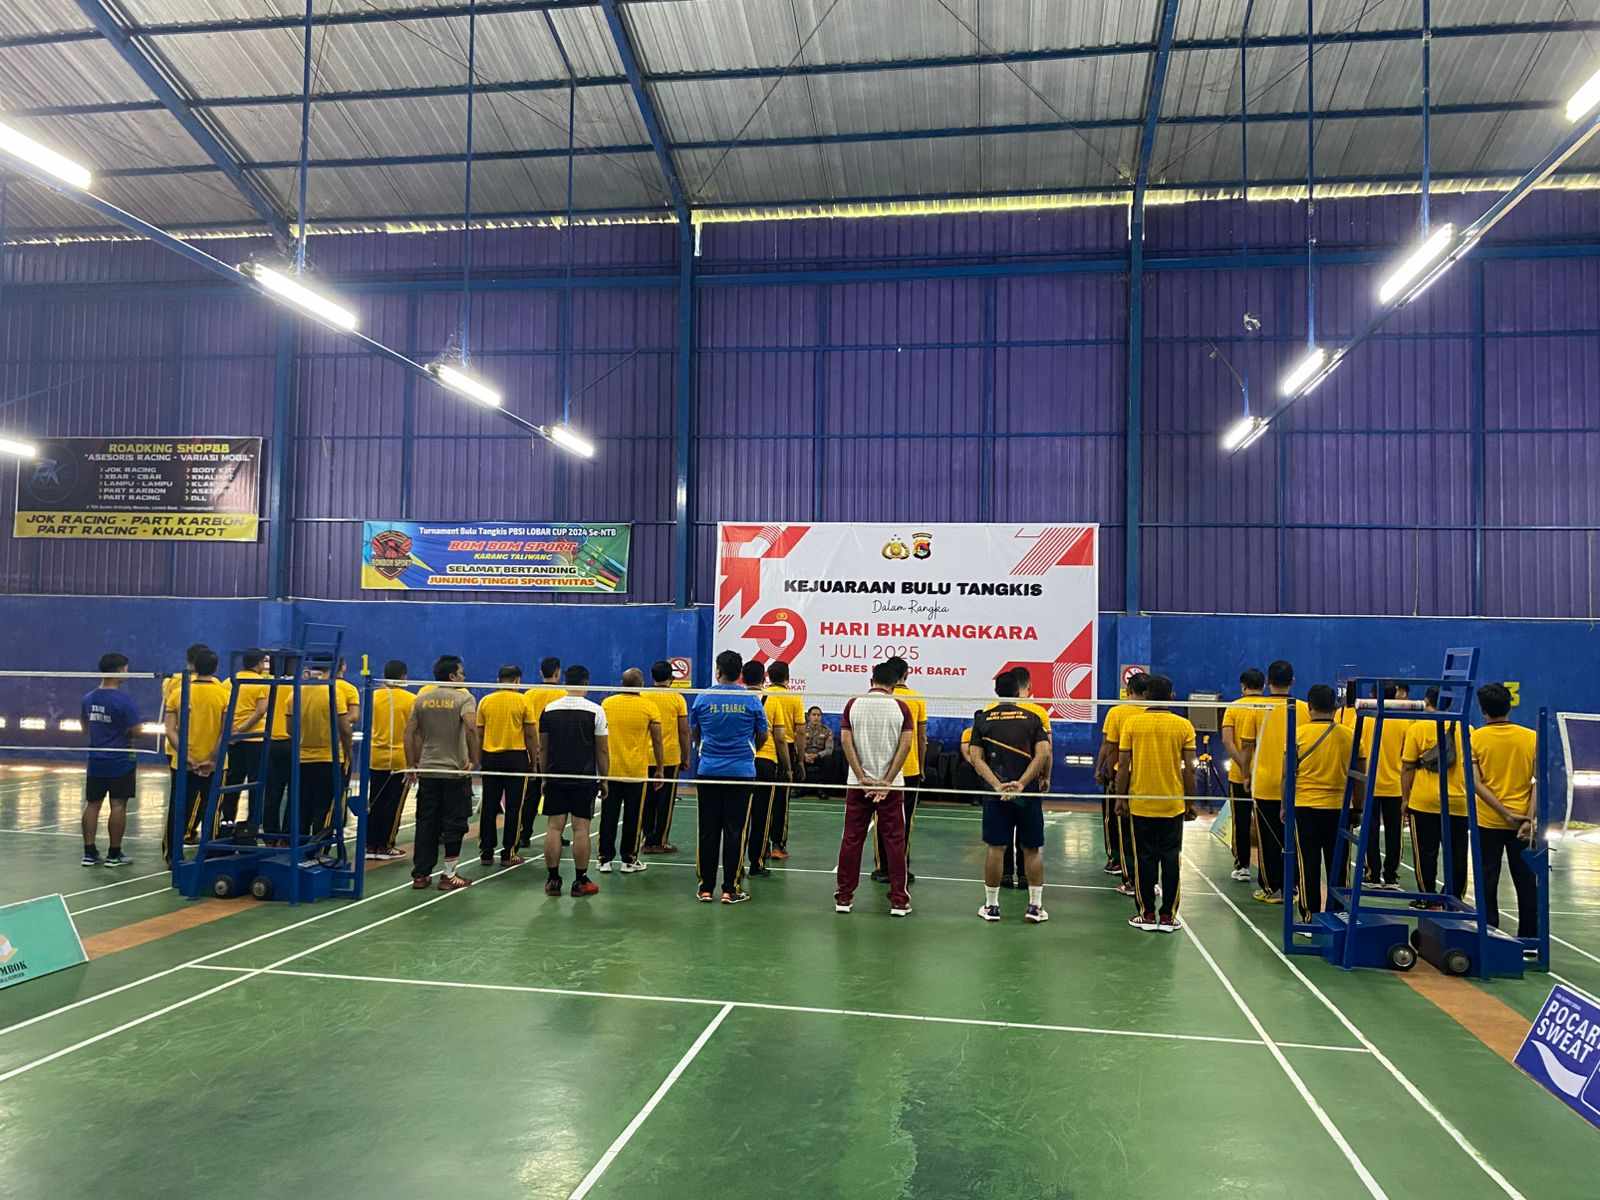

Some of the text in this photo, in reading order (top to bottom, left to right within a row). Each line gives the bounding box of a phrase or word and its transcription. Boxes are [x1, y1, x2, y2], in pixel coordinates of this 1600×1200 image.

[109, 444, 172, 453] ROADKING
[180, 454, 218, 462] VARIASI
[26, 514, 55, 524] JOK
[61, 515, 117, 525] RACING
[131, 516, 173, 526] PART
[178, 516, 244, 526] KARBON
[36, 525, 78, 534] PART
[82, 526, 139, 536] RACING
[152, 526, 227, 537] KNALPOT
[460, 527, 477, 535] Bulu
[478, 527, 508, 536] Tangkis
[508, 528, 525, 536] PBSI
[526, 528, 551, 536] LOBAR
[568, 528, 588, 536] 2024
[588, 528, 617, 536] Se-NTB
[524, 541, 578, 552] SPORT
[448, 565, 577, 574] SELAMAT BERTANDING
[429, 576, 596, 586] JUNJUNG TINGGI SPORTIVITAS
[784, 580, 1042, 597] KEJUARAAN BULU TANGKIS
[872, 600, 949, 620] Dalam Rangka
[820, 622, 1038, 640] HARI BHAYANGKARA
[818, 644, 920, 660] 1 JULI 2025
[822, 664, 868, 673] POLRES
[927, 666, 968, 676] BARAT
[1546, 1000, 1600, 1050] POCAR
[1536, 1018, 1594, 1064] SWEAT
